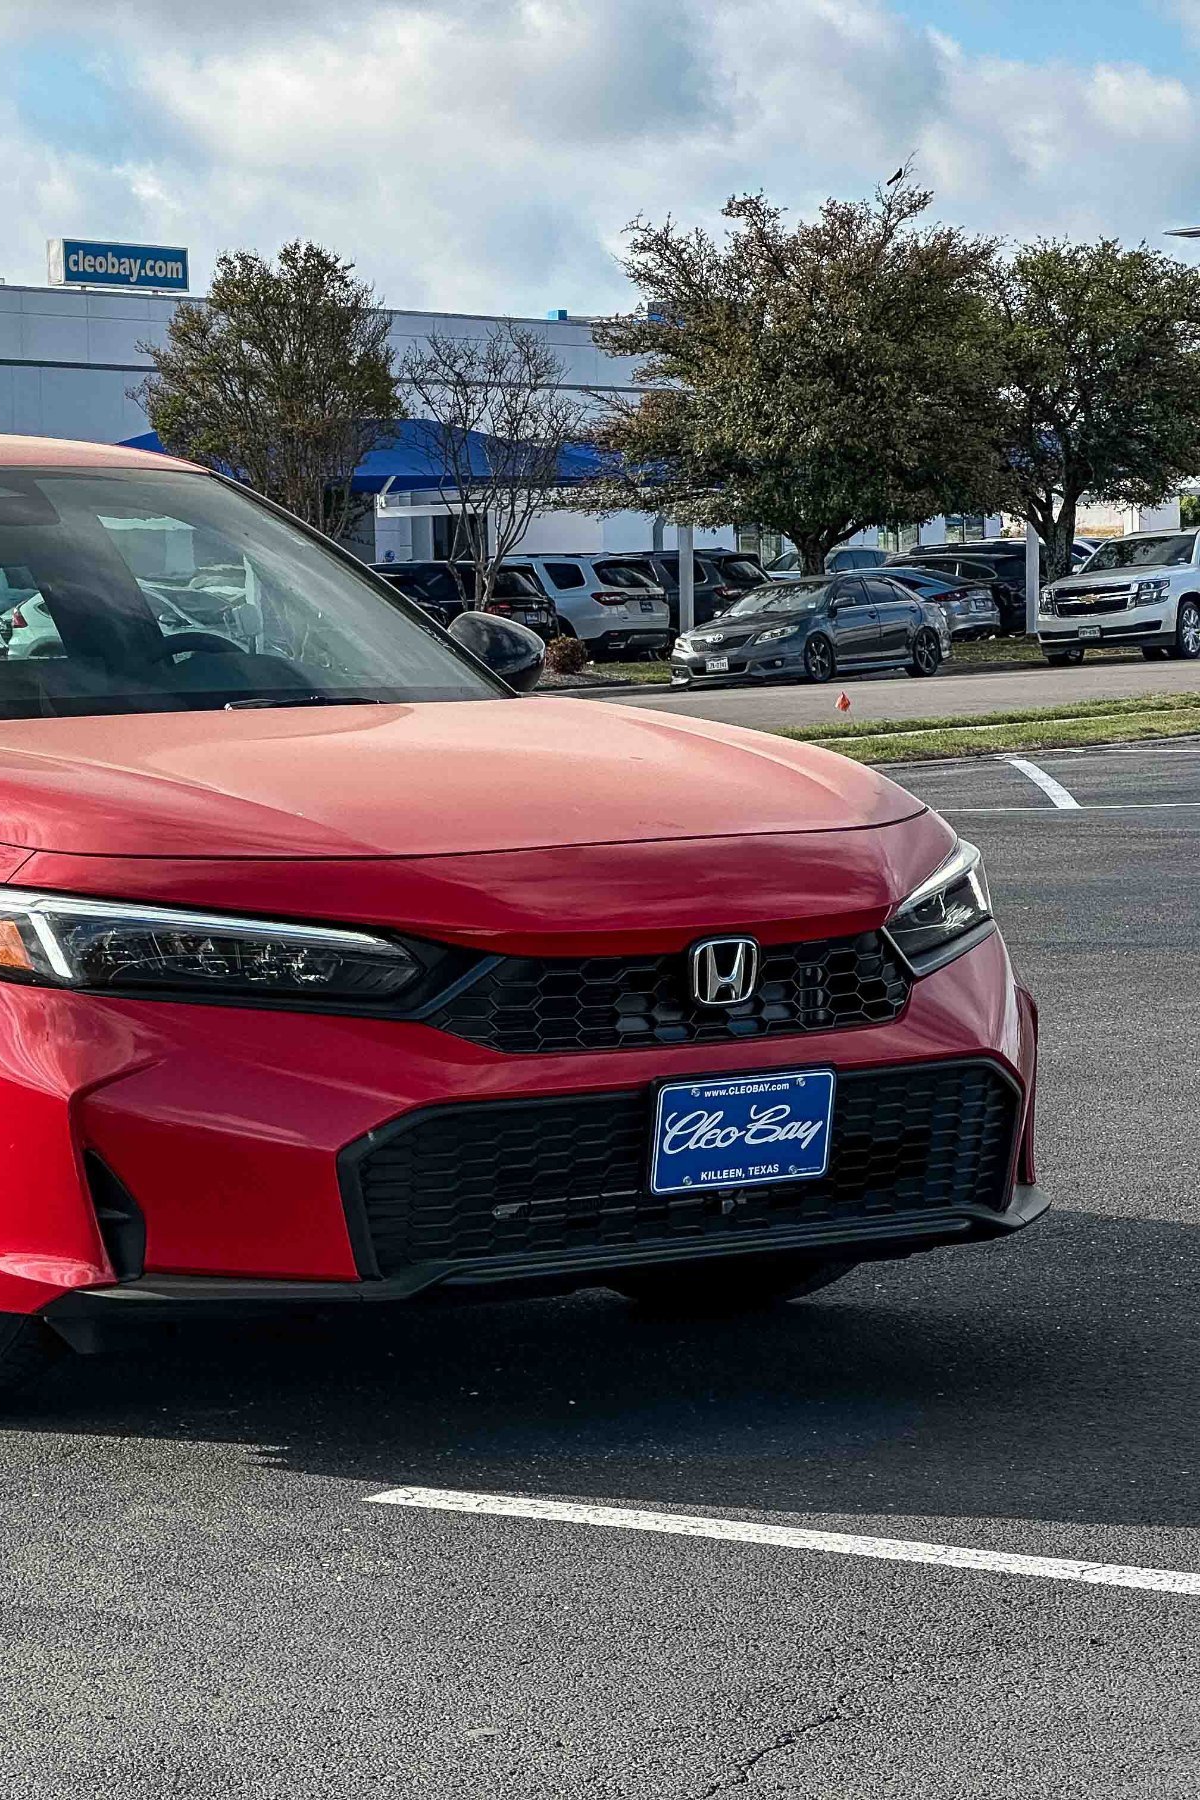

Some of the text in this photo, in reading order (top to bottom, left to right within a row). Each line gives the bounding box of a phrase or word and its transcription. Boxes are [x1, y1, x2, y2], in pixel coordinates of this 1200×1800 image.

[68, 250, 183, 282] cleobay.com
[704, 1082, 790, 1098] www.CLEOBAY.com
[663, 1104, 823, 1155] Cleo Bay
[701, 1164, 779, 1181] KILLEEN, TEXAS
